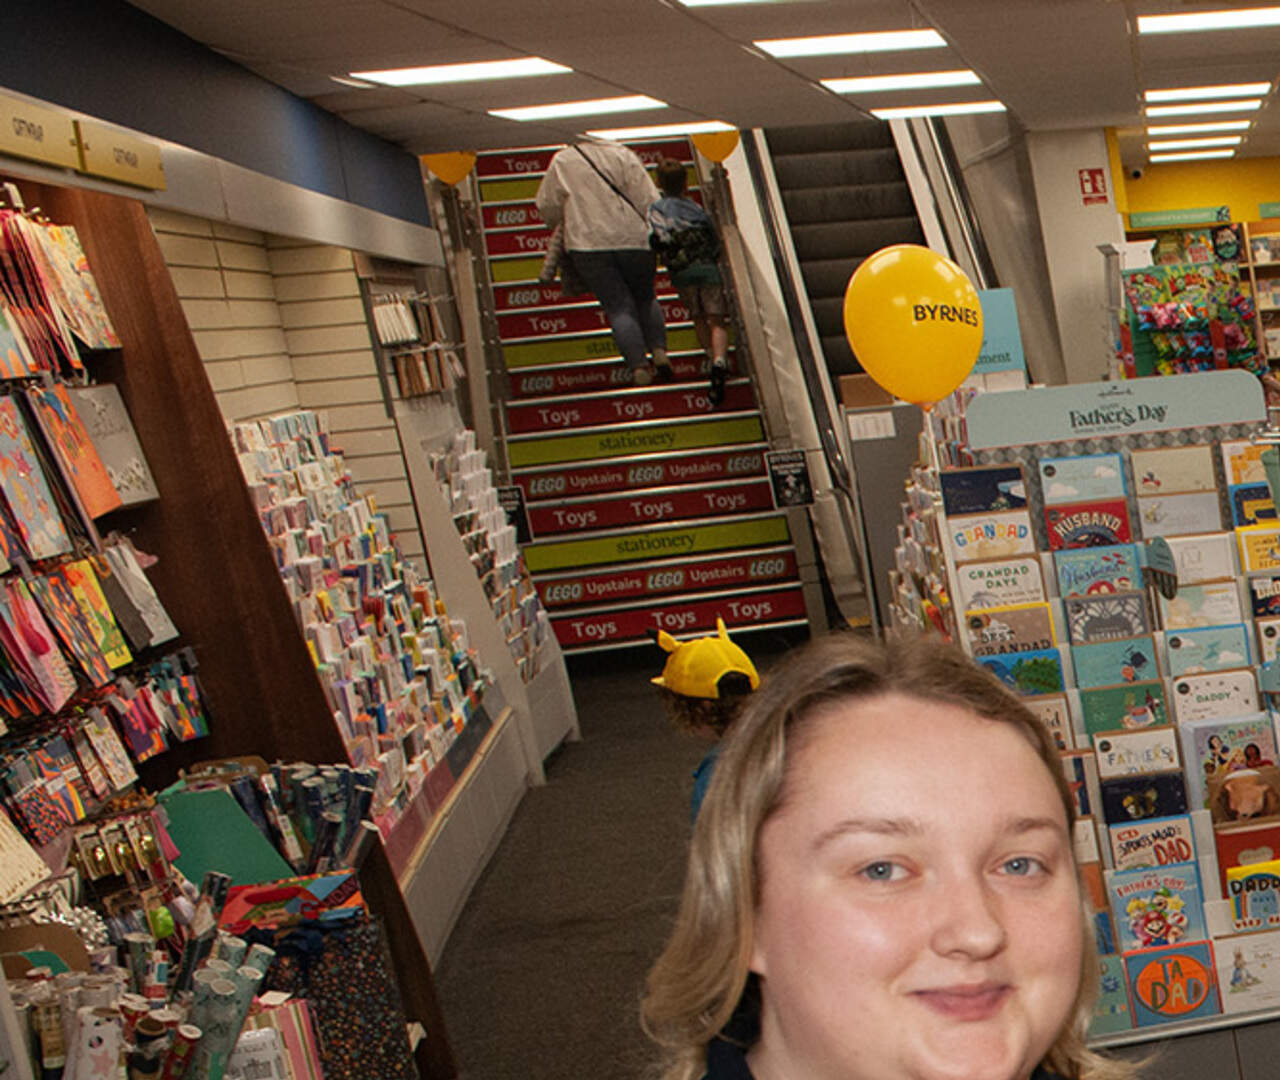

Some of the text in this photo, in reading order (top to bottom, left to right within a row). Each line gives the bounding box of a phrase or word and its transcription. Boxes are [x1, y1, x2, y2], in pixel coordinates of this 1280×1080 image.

[505, 157, 541, 174] Toys
[495, 209, 527, 226] LEGO
[508, 289, 540, 305] LEGO
[528, 304, 690, 333] Toys Toy
[913, 304, 978, 327] BYRNES
[538, 395, 715, 427] Toys Toys Toy
[1069, 404, 1169, 427] Father's Day
[599, 430, 677, 451] stationery
[530, 477, 566, 494] LEGO
[570, 471, 623, 489] Upstairs
[628, 466, 663, 483] LEGO
[669, 461, 722, 478] Upstairs
[727, 455, 761, 473] LEGO
[553, 492, 747, 527] Toys Toys Toys
[954, 524, 1029, 548] GRANDAD
[1053, 512, 1122, 537] HUSBAND
[616, 533, 697, 554] stationery
[545, 558, 785, 601] LEGO Upstairs LEGO Upstairs LEGO
[968, 565, 1029, 580] GRANDAD
[985, 578, 1018, 589] DAYS
[572, 600, 772, 639] Toys Toys Toys
[1153, 838, 1192, 865] DAD
[1156, 959, 1184, 984] TA
[1151, 978, 1205, 1011] DAD
